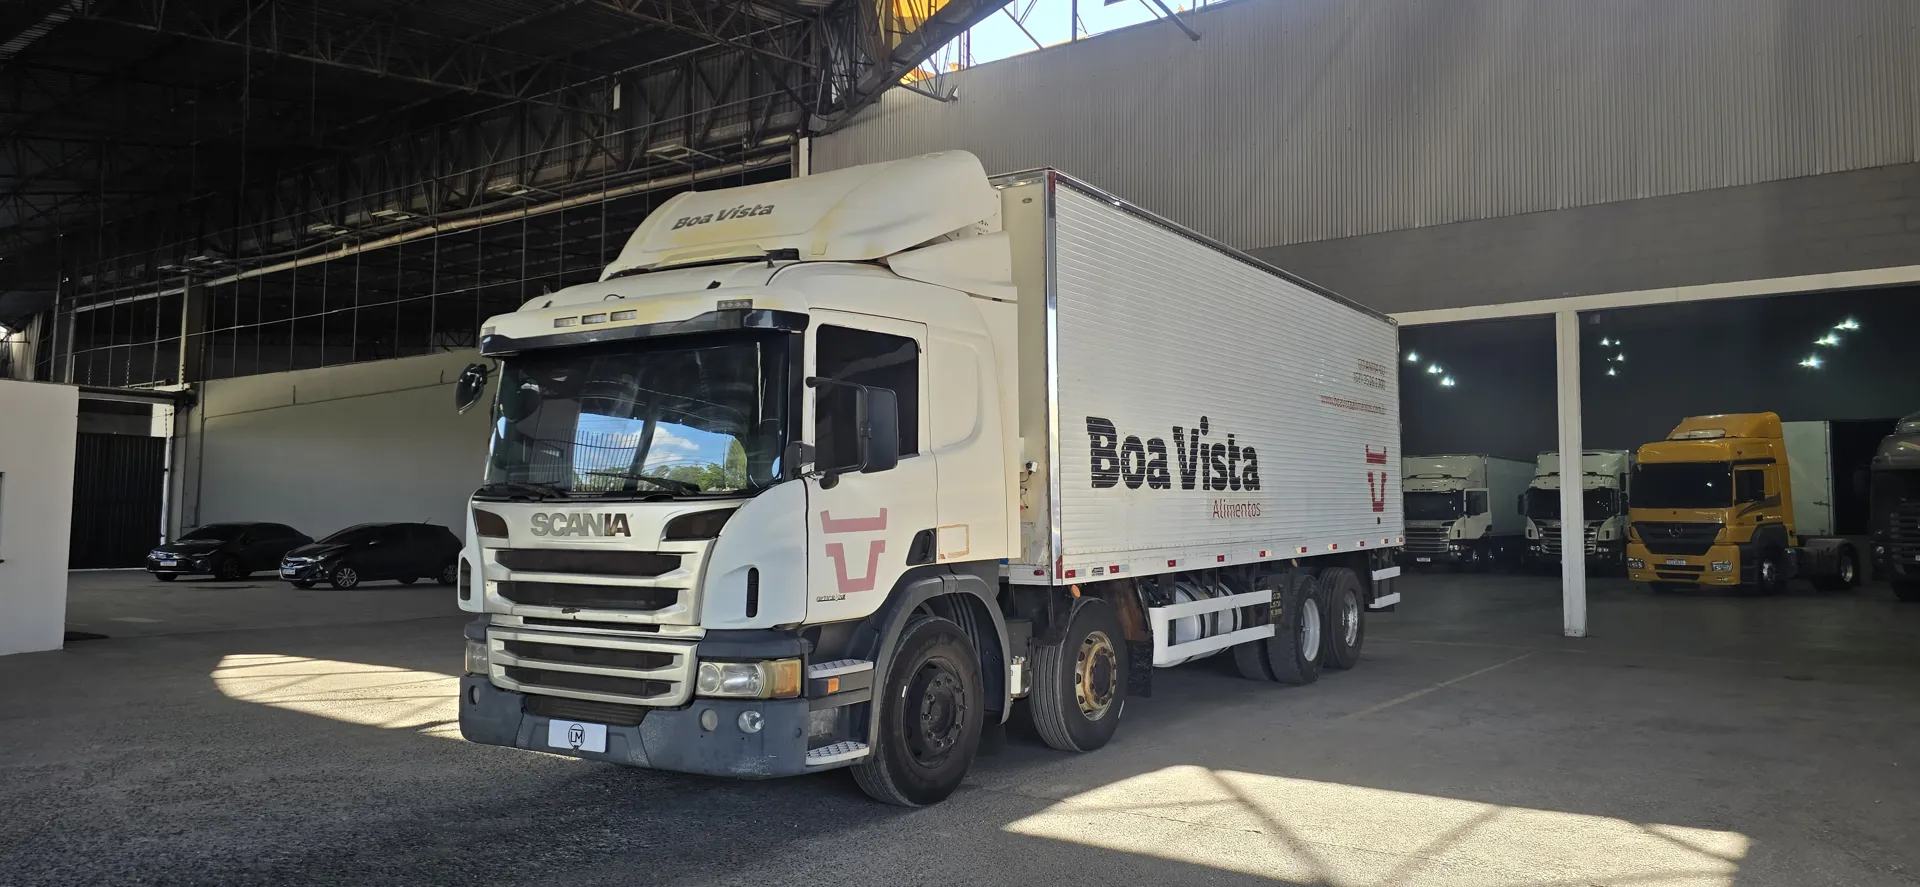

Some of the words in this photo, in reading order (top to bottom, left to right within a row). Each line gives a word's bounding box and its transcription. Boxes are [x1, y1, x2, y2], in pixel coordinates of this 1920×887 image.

[671, 213, 713, 230] Boa
[715, 203, 775, 222] Vista
[1086, 416, 1171, 490] Boa
[1172, 415, 1261, 491] Vista
[1212, 498, 1261, 519] Alimentos
[530, 512, 632, 537] SCANIA
